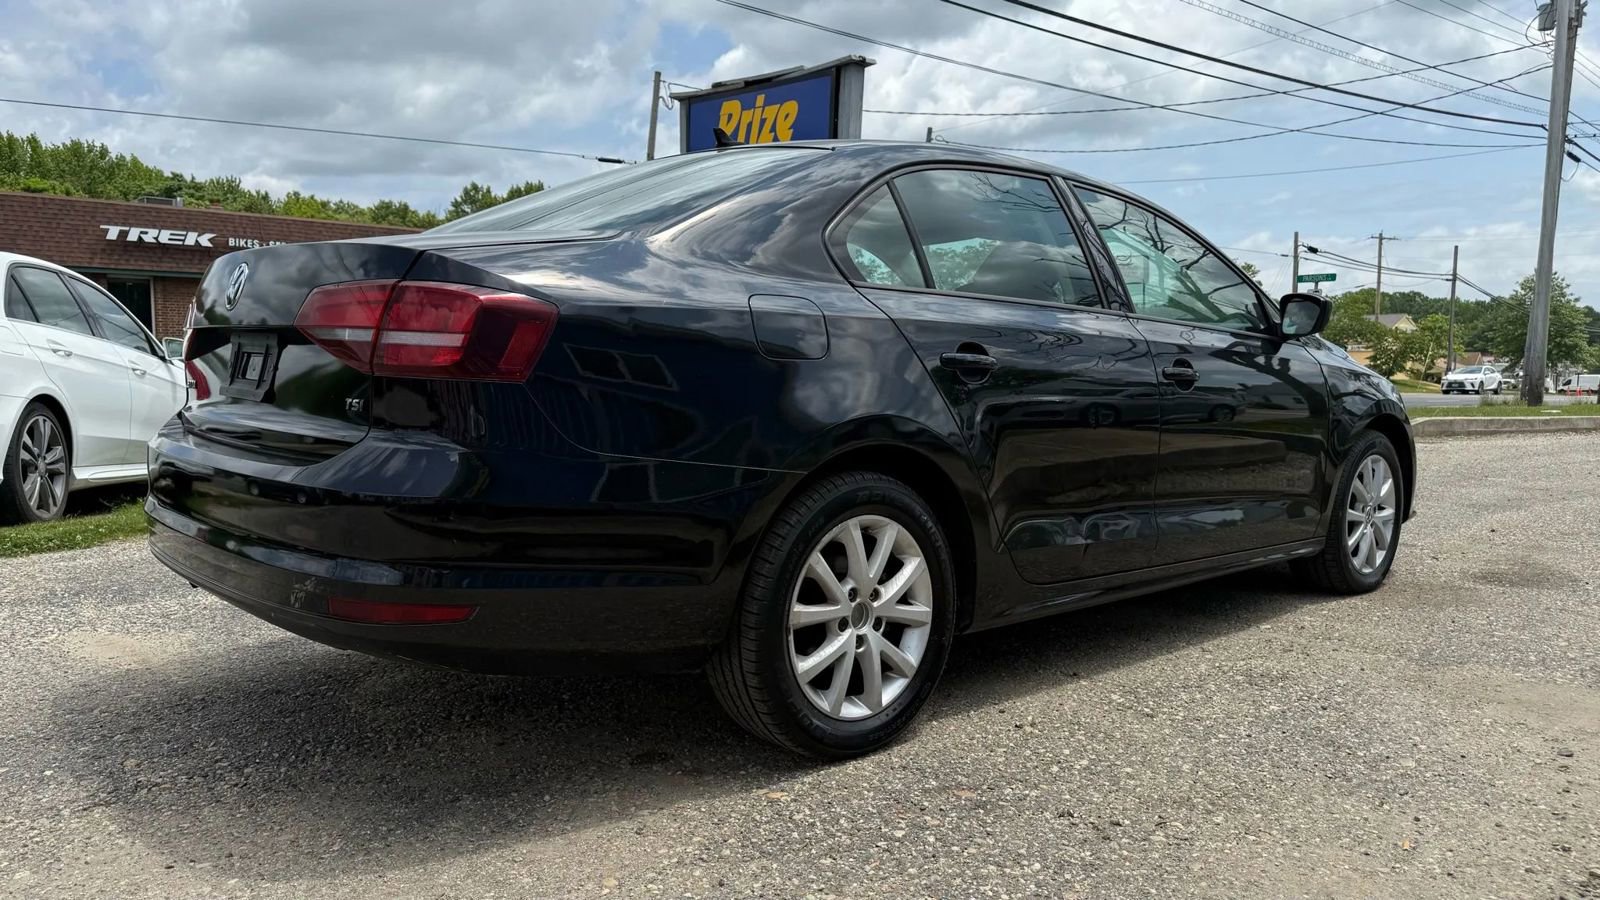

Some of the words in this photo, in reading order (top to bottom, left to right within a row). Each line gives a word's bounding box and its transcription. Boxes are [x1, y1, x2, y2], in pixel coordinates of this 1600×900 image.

[719, 94, 799, 144] Prize
[100, 225, 217, 248] TREK
[228, 237, 260, 248] BIKES
[344, 397, 365, 412] TSI
